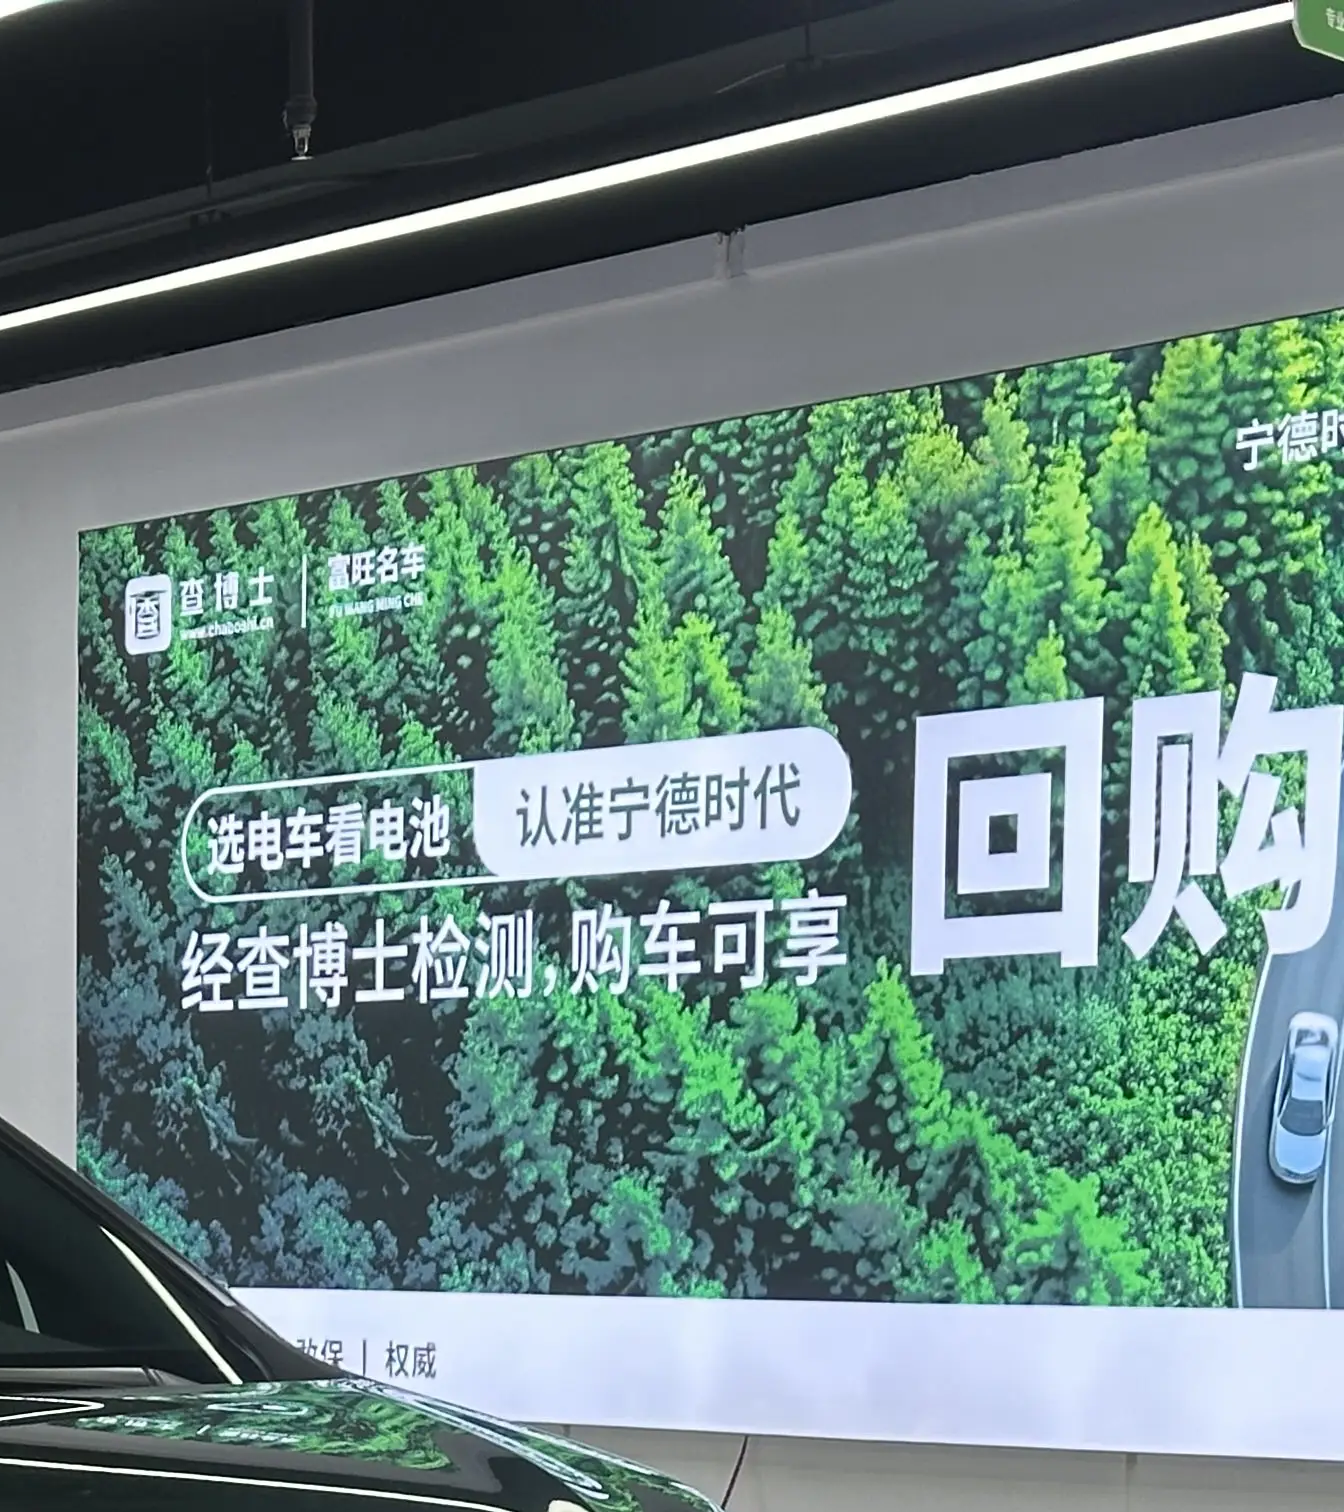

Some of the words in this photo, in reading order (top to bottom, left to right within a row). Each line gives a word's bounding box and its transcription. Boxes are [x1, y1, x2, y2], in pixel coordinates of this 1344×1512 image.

[179, 566, 274, 616] 查博士
[327, 542, 425, 592] 富旺名车
[207, 793, 451, 875] 选电车看电池
[515, 761, 802, 848] 认准宁德时代
[912, 672, 1344, 976] 回购
[385, 1340, 437, 1379] 权威
